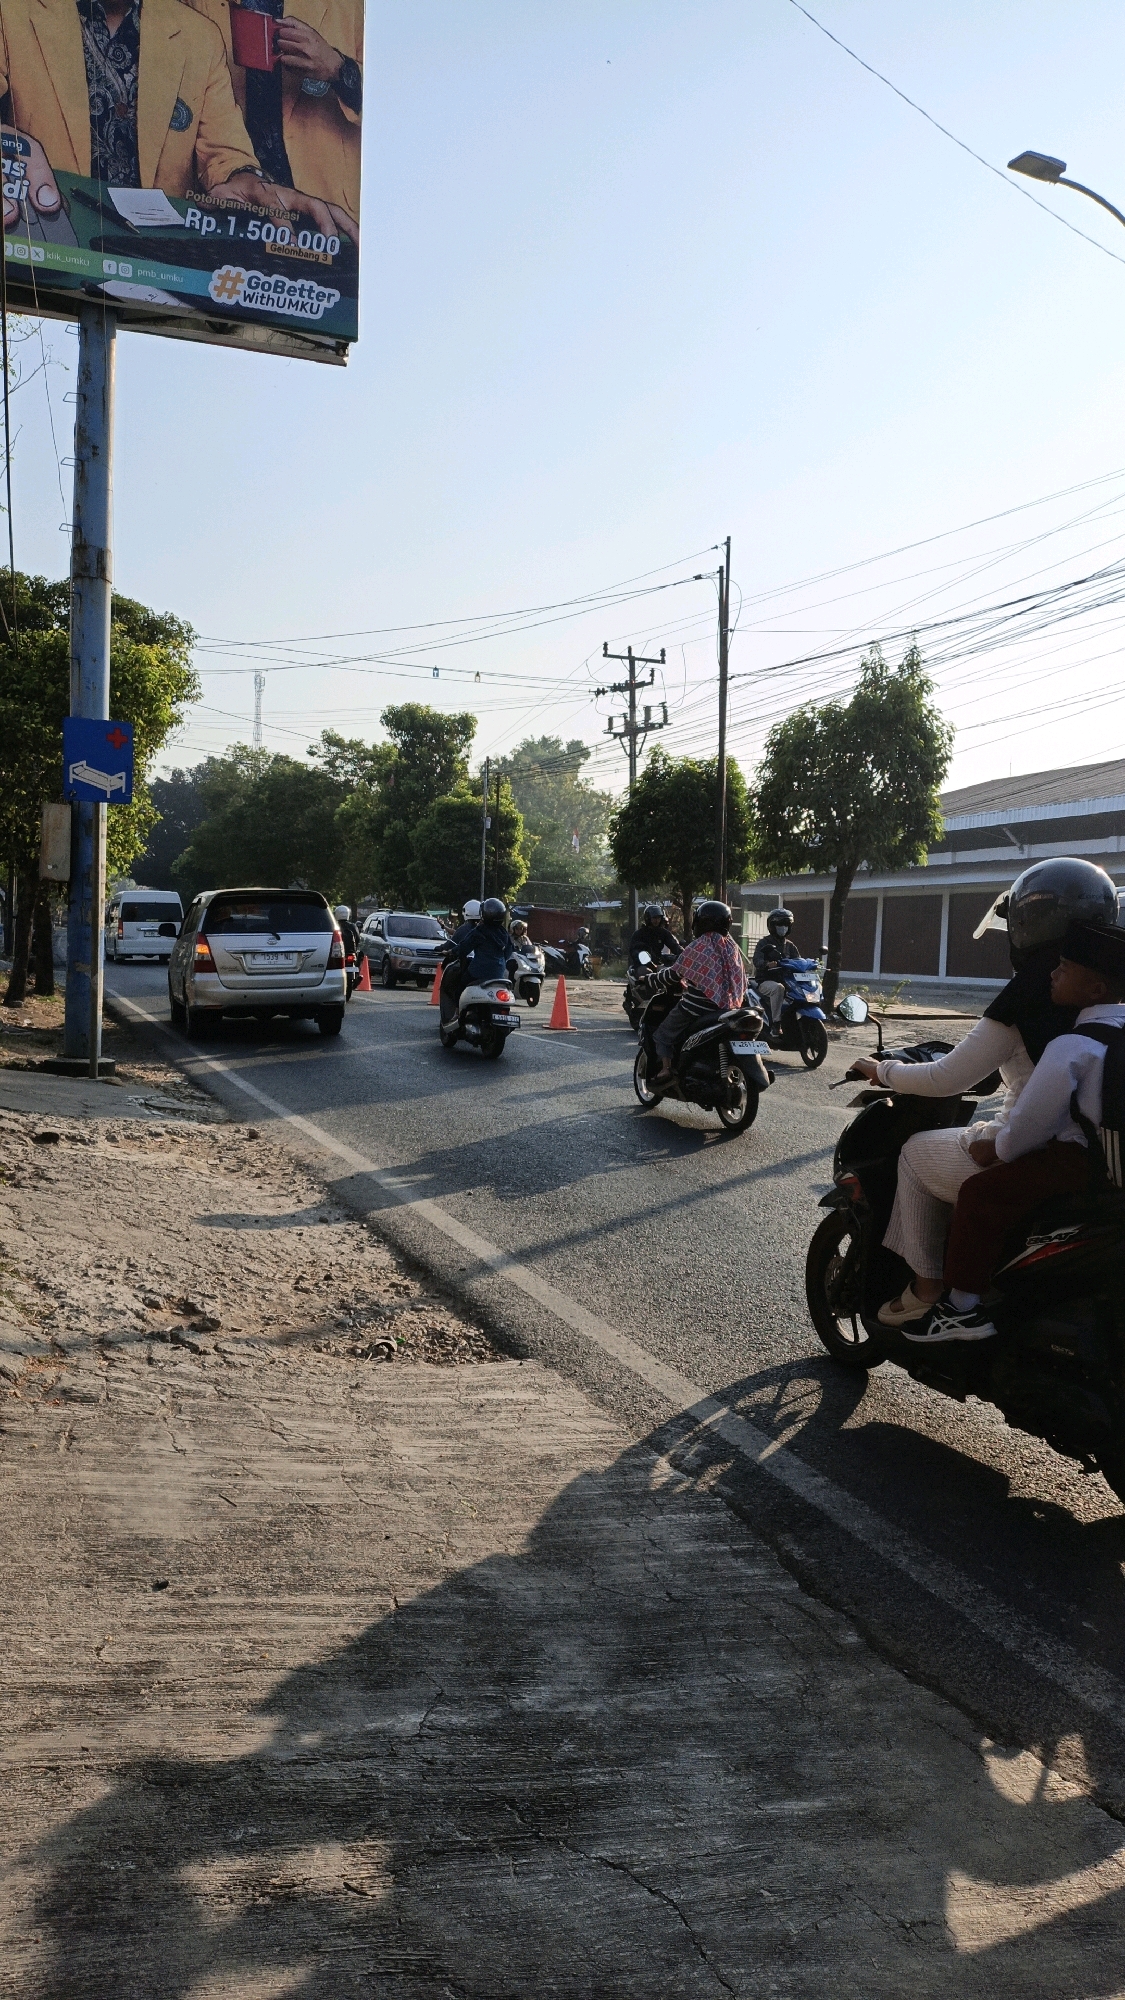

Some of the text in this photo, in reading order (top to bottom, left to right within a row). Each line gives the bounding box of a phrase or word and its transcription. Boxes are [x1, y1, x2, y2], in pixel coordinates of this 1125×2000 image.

[185, 189, 300, 222] Potongan Registrasi
[184, 207, 340, 256] Rp.1.500.000
[46, 251, 90, 267] klik_umku
[270, 243, 329, 262] Gelombang 3
[137, 267, 184, 284] pmb_umku
[243, 290, 321, 316] WithUMKU
